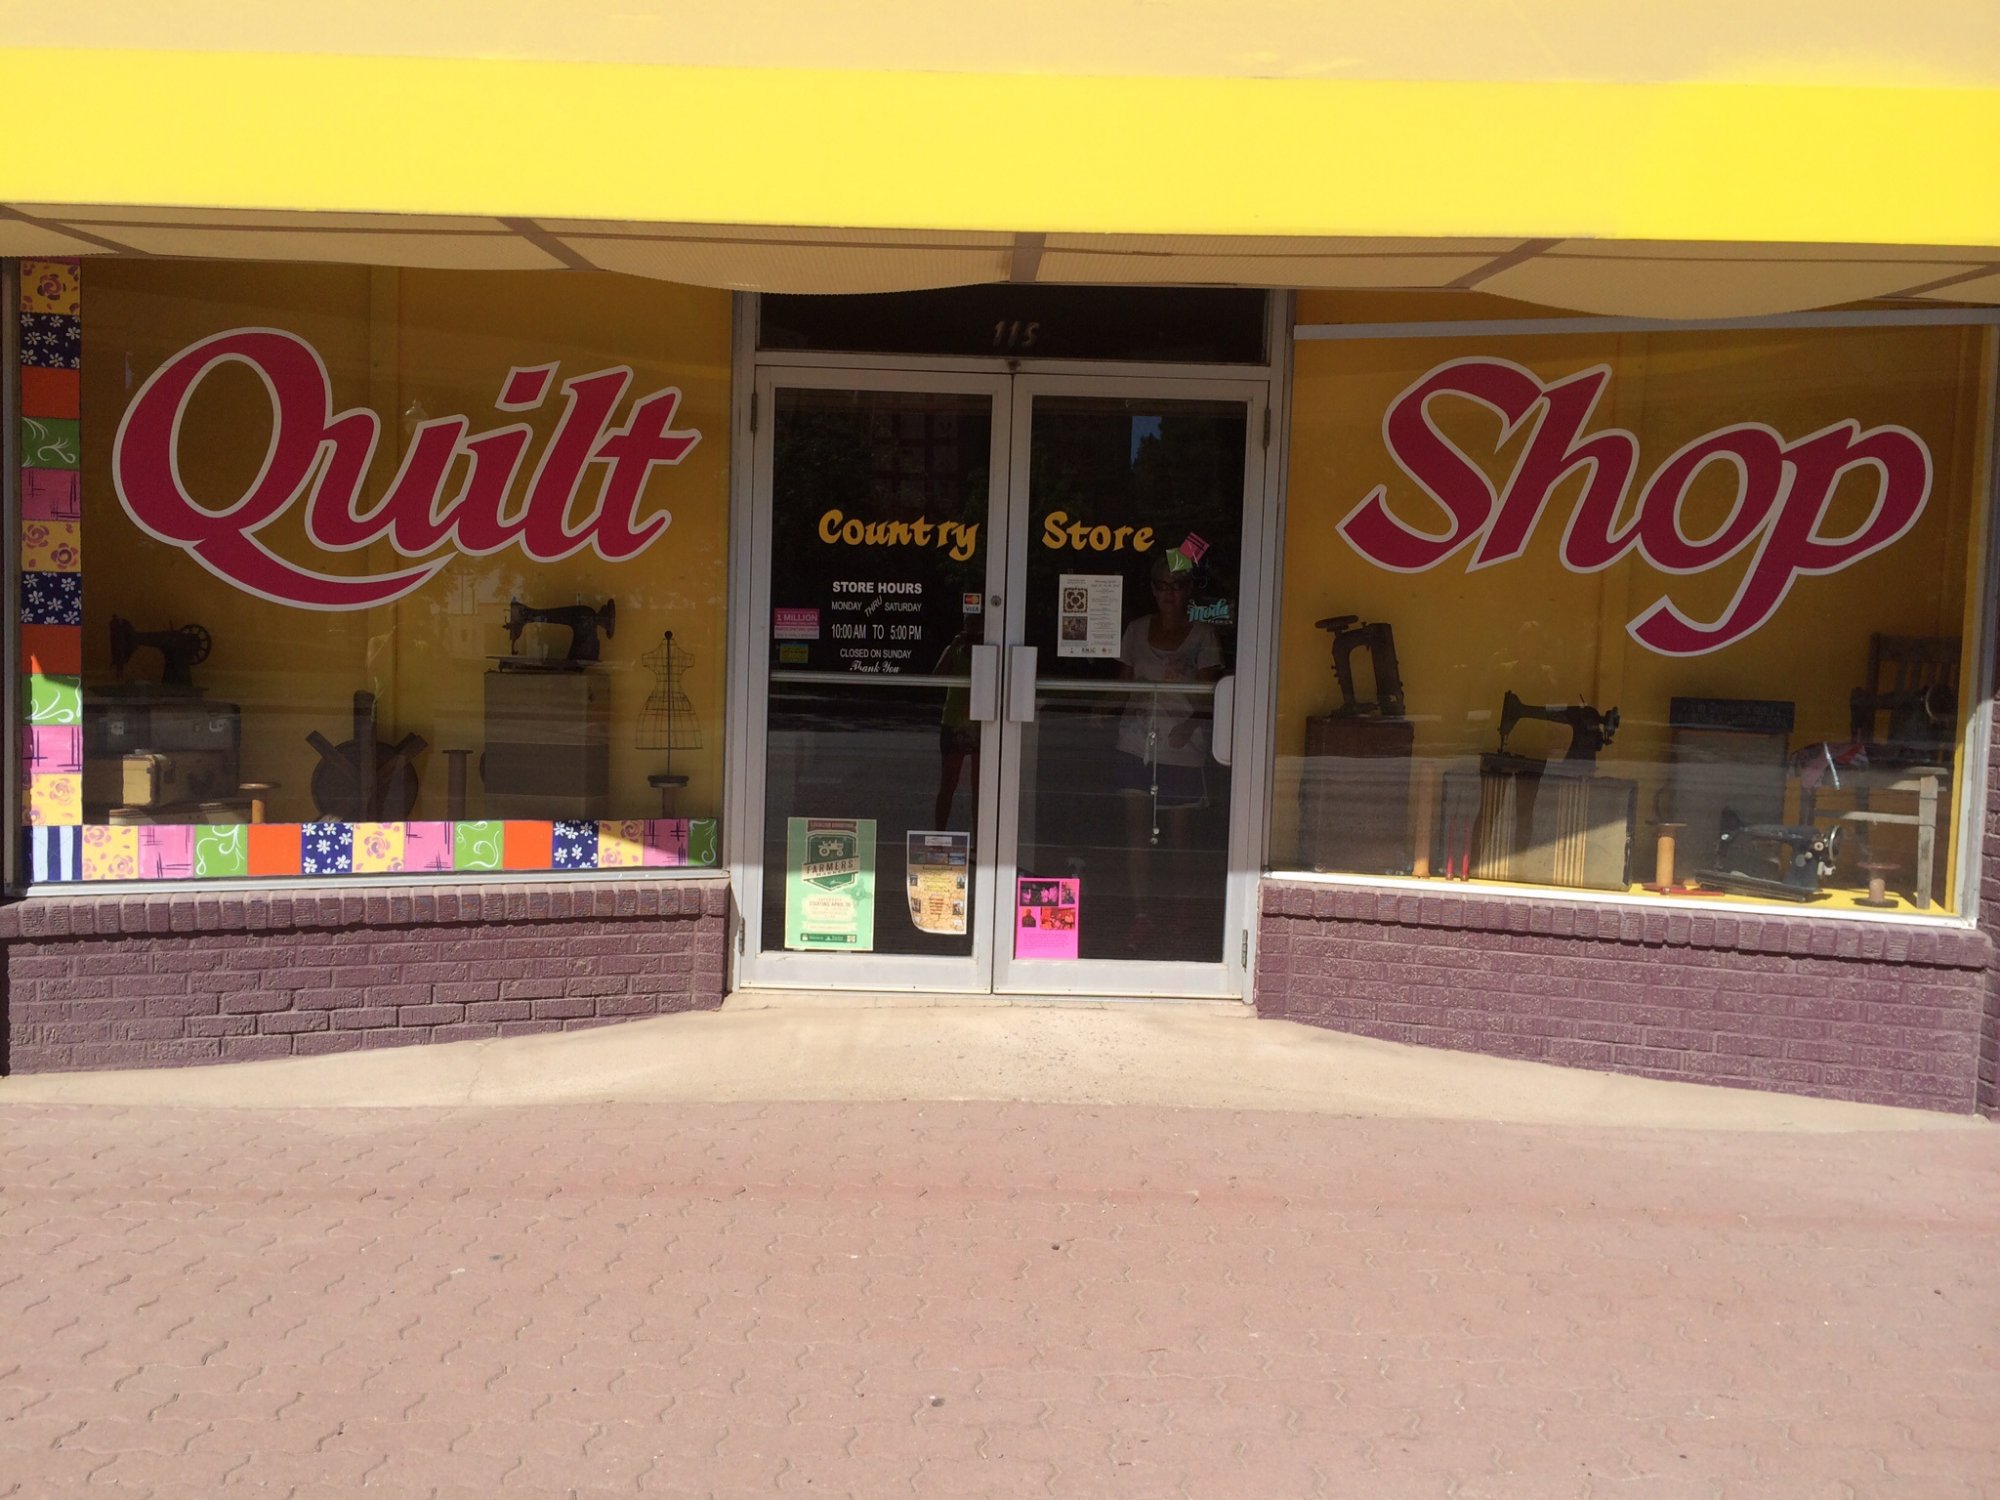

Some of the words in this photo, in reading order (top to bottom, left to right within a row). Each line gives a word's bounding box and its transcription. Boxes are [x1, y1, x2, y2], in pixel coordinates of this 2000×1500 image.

[112, 326, 701, 611] Quilt
[1335, 356, 1933, 657] Shop
[818, 509, 979, 561] Country
[1042, 511, 1155, 552] Store
[832, 581, 874, 593] STORE
[878, 582, 922, 594] HOURS
[831, 601, 862, 611] MONDAY
[864, 595, 883, 617] THRU
[884, 602, 922, 612] SATURDAY
[831, 624, 852, 639] 10:00
[853, 624, 867, 639] AM
[872, 624, 885, 640] TO
[890, 625, 908, 640] 5:00
[908, 625, 922, 640] PM
[839, 648, 869, 658] CLOSED
[870, 649, 882, 658] ON
[882, 650, 912, 659] SUNDAY
[849, 660, 880, 673] Thank
[882, 660, 901, 673] You
